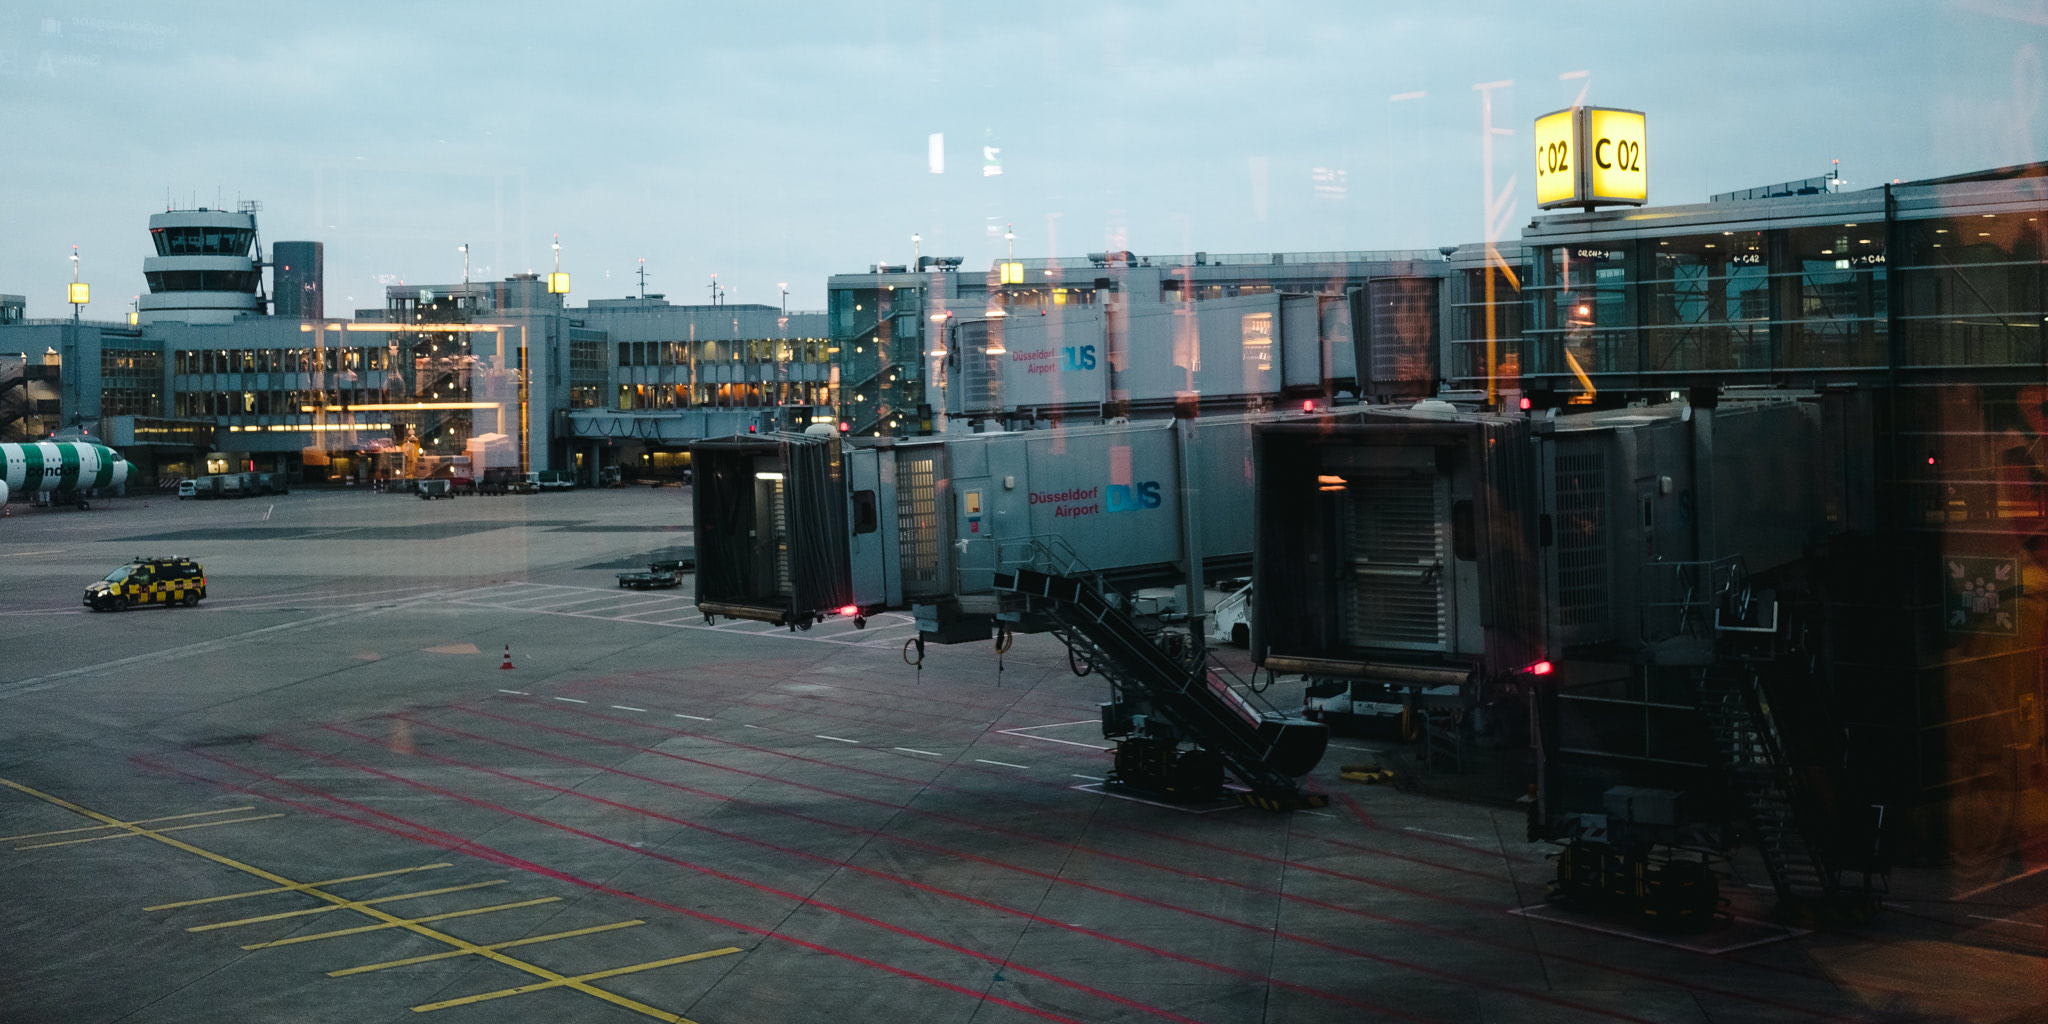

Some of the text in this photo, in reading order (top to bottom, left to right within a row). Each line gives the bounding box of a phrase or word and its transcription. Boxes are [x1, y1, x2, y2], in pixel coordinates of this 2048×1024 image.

[1538, 140, 1568, 177] C 02
[1595, 138, 1640, 172] C 02
[1742, 254, 1760, 264] C42
[1867, 254, 1886, 264] C44
[1012, 347, 1055, 362] Düsseldorf
[1061, 344, 1097, 371] DUS
[1028, 363, 1056, 376] Airport
[26, 464, 78, 477] condor
[1028, 486, 1099, 505] Düsseldorf
[1106, 480, 1162, 513] DUS
[1054, 503, 1099, 519] Airport
